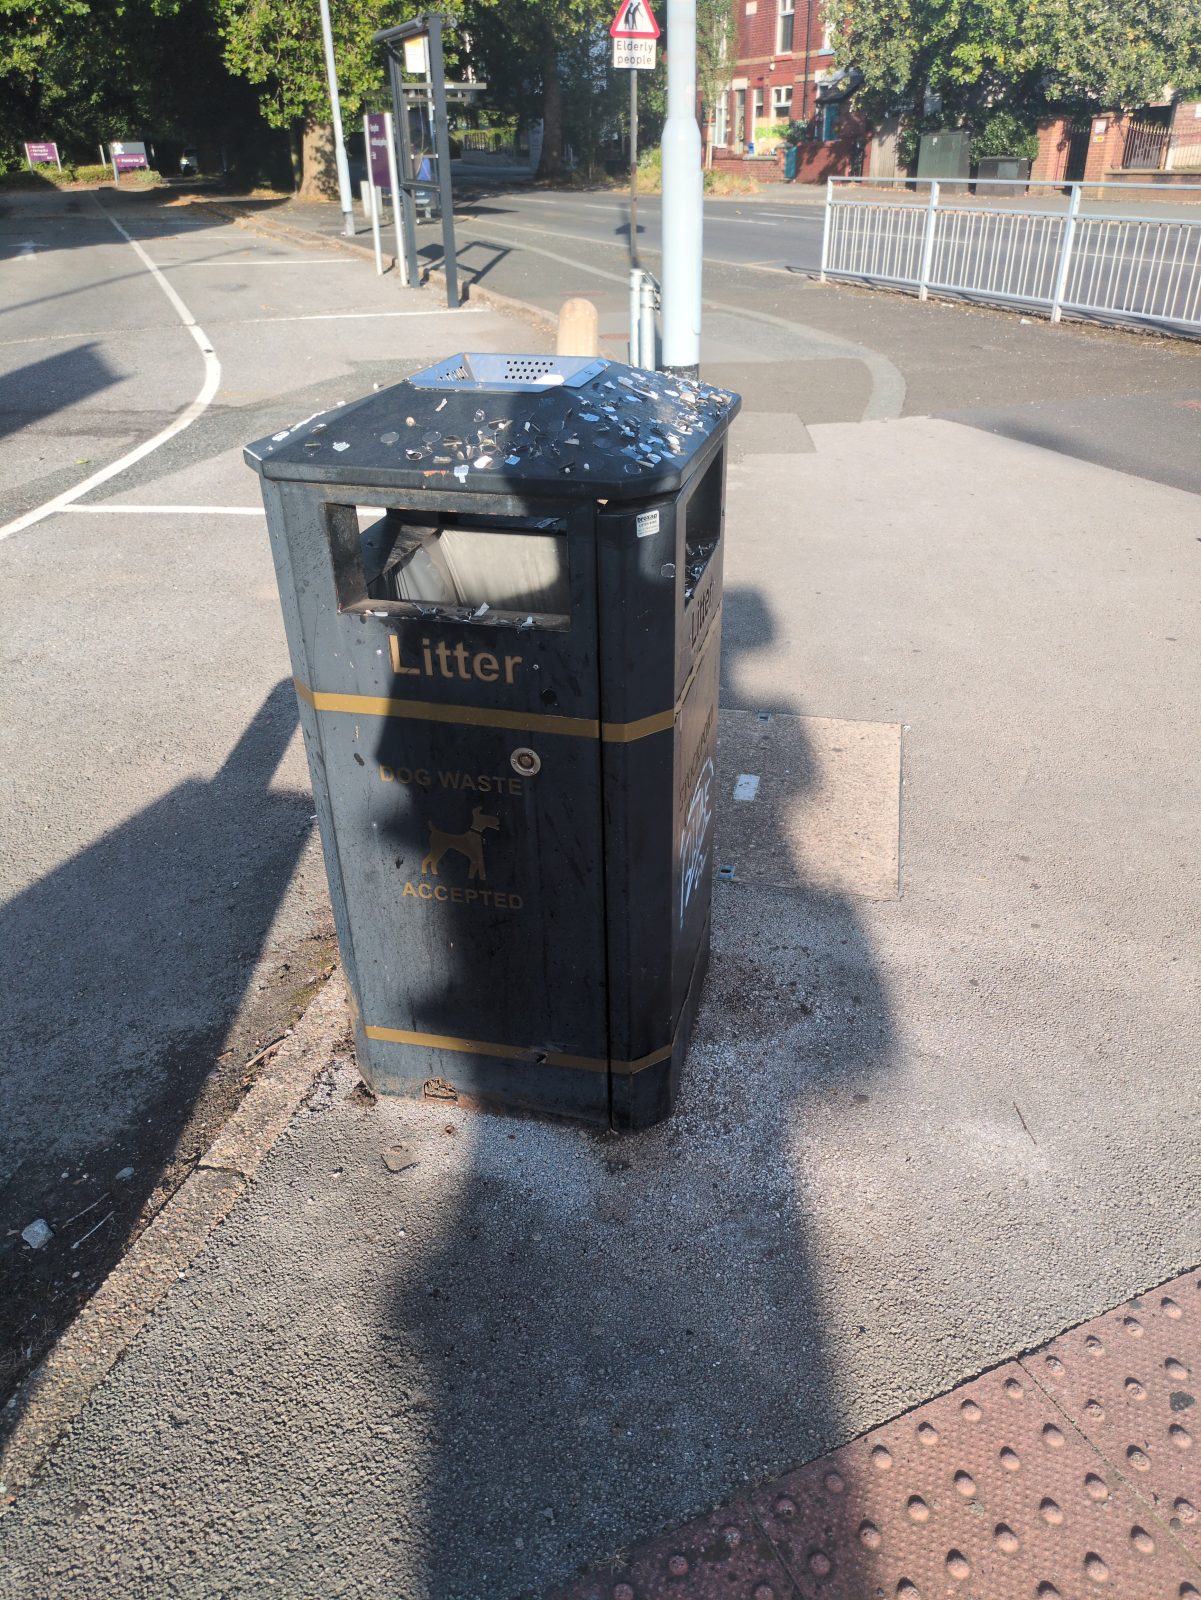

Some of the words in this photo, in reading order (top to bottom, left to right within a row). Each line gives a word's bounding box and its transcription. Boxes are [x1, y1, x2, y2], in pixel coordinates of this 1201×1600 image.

[616, 40, 653, 54] Elderly
[617, 55, 652, 65] people
[690, 578, 715, 648] Litter
[388, 634, 524, 684] Litter
[379, 764, 432, 786] DOG
[437, 769, 524, 796] WASTE
[402, 881, 524, 910] ACCEPTED
